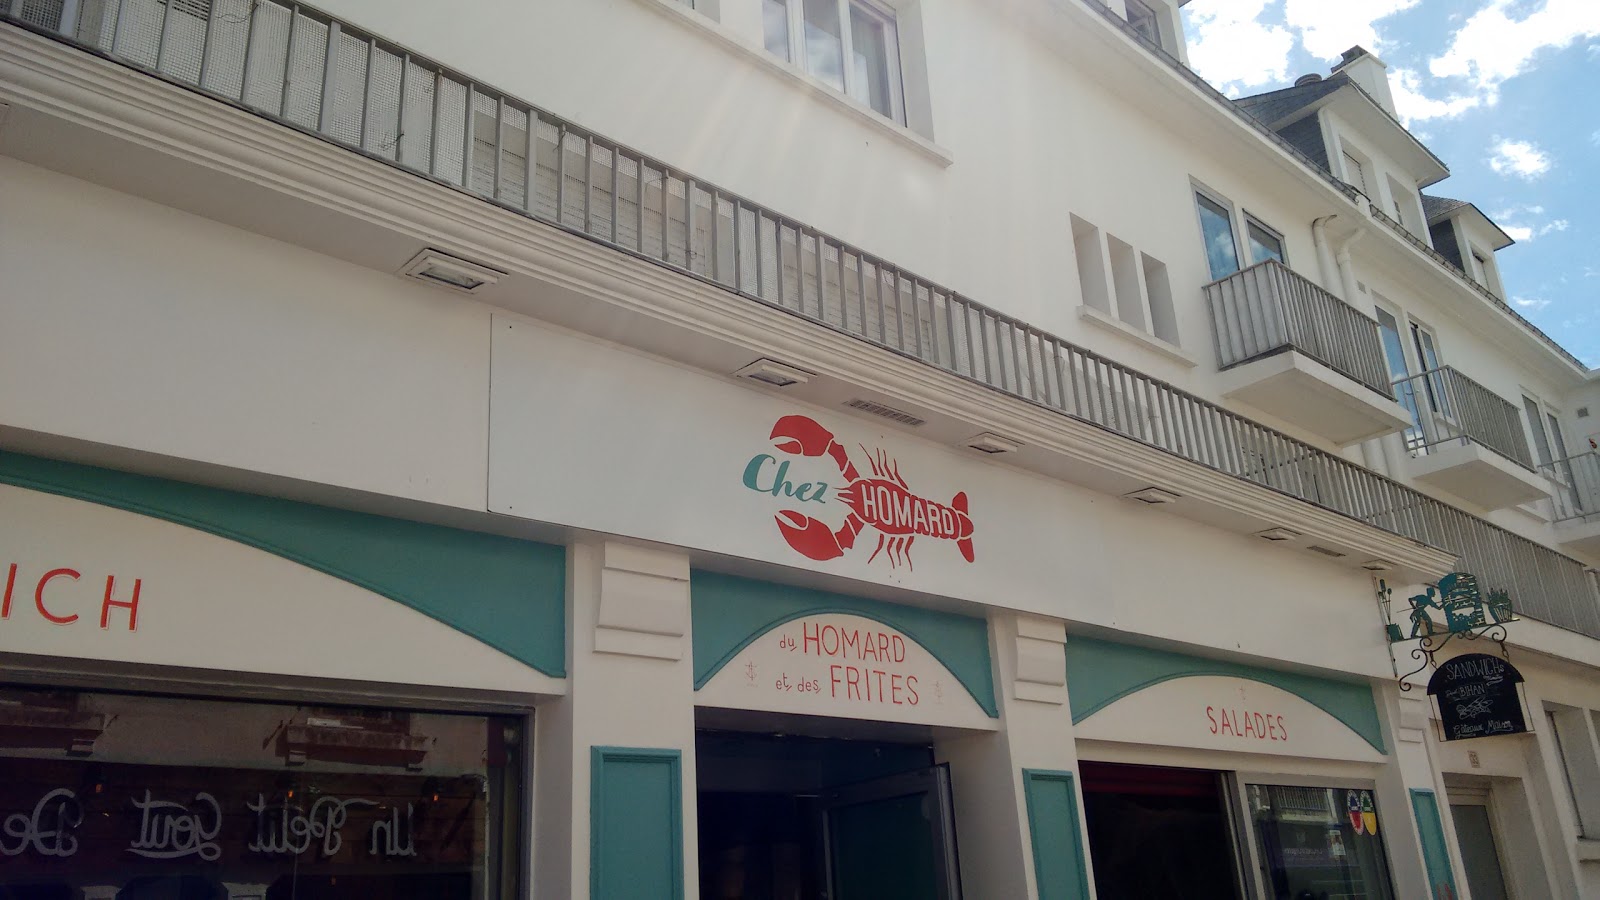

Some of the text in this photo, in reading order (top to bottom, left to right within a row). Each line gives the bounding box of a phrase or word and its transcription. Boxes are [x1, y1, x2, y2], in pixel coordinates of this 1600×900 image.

[742, 453, 957, 536] Chez HOMARD
[779, 621, 906, 663] du HOMARD
[775, 664, 920, 706] et des FRITES
[1206, 705, 1288, 741] SALADES
